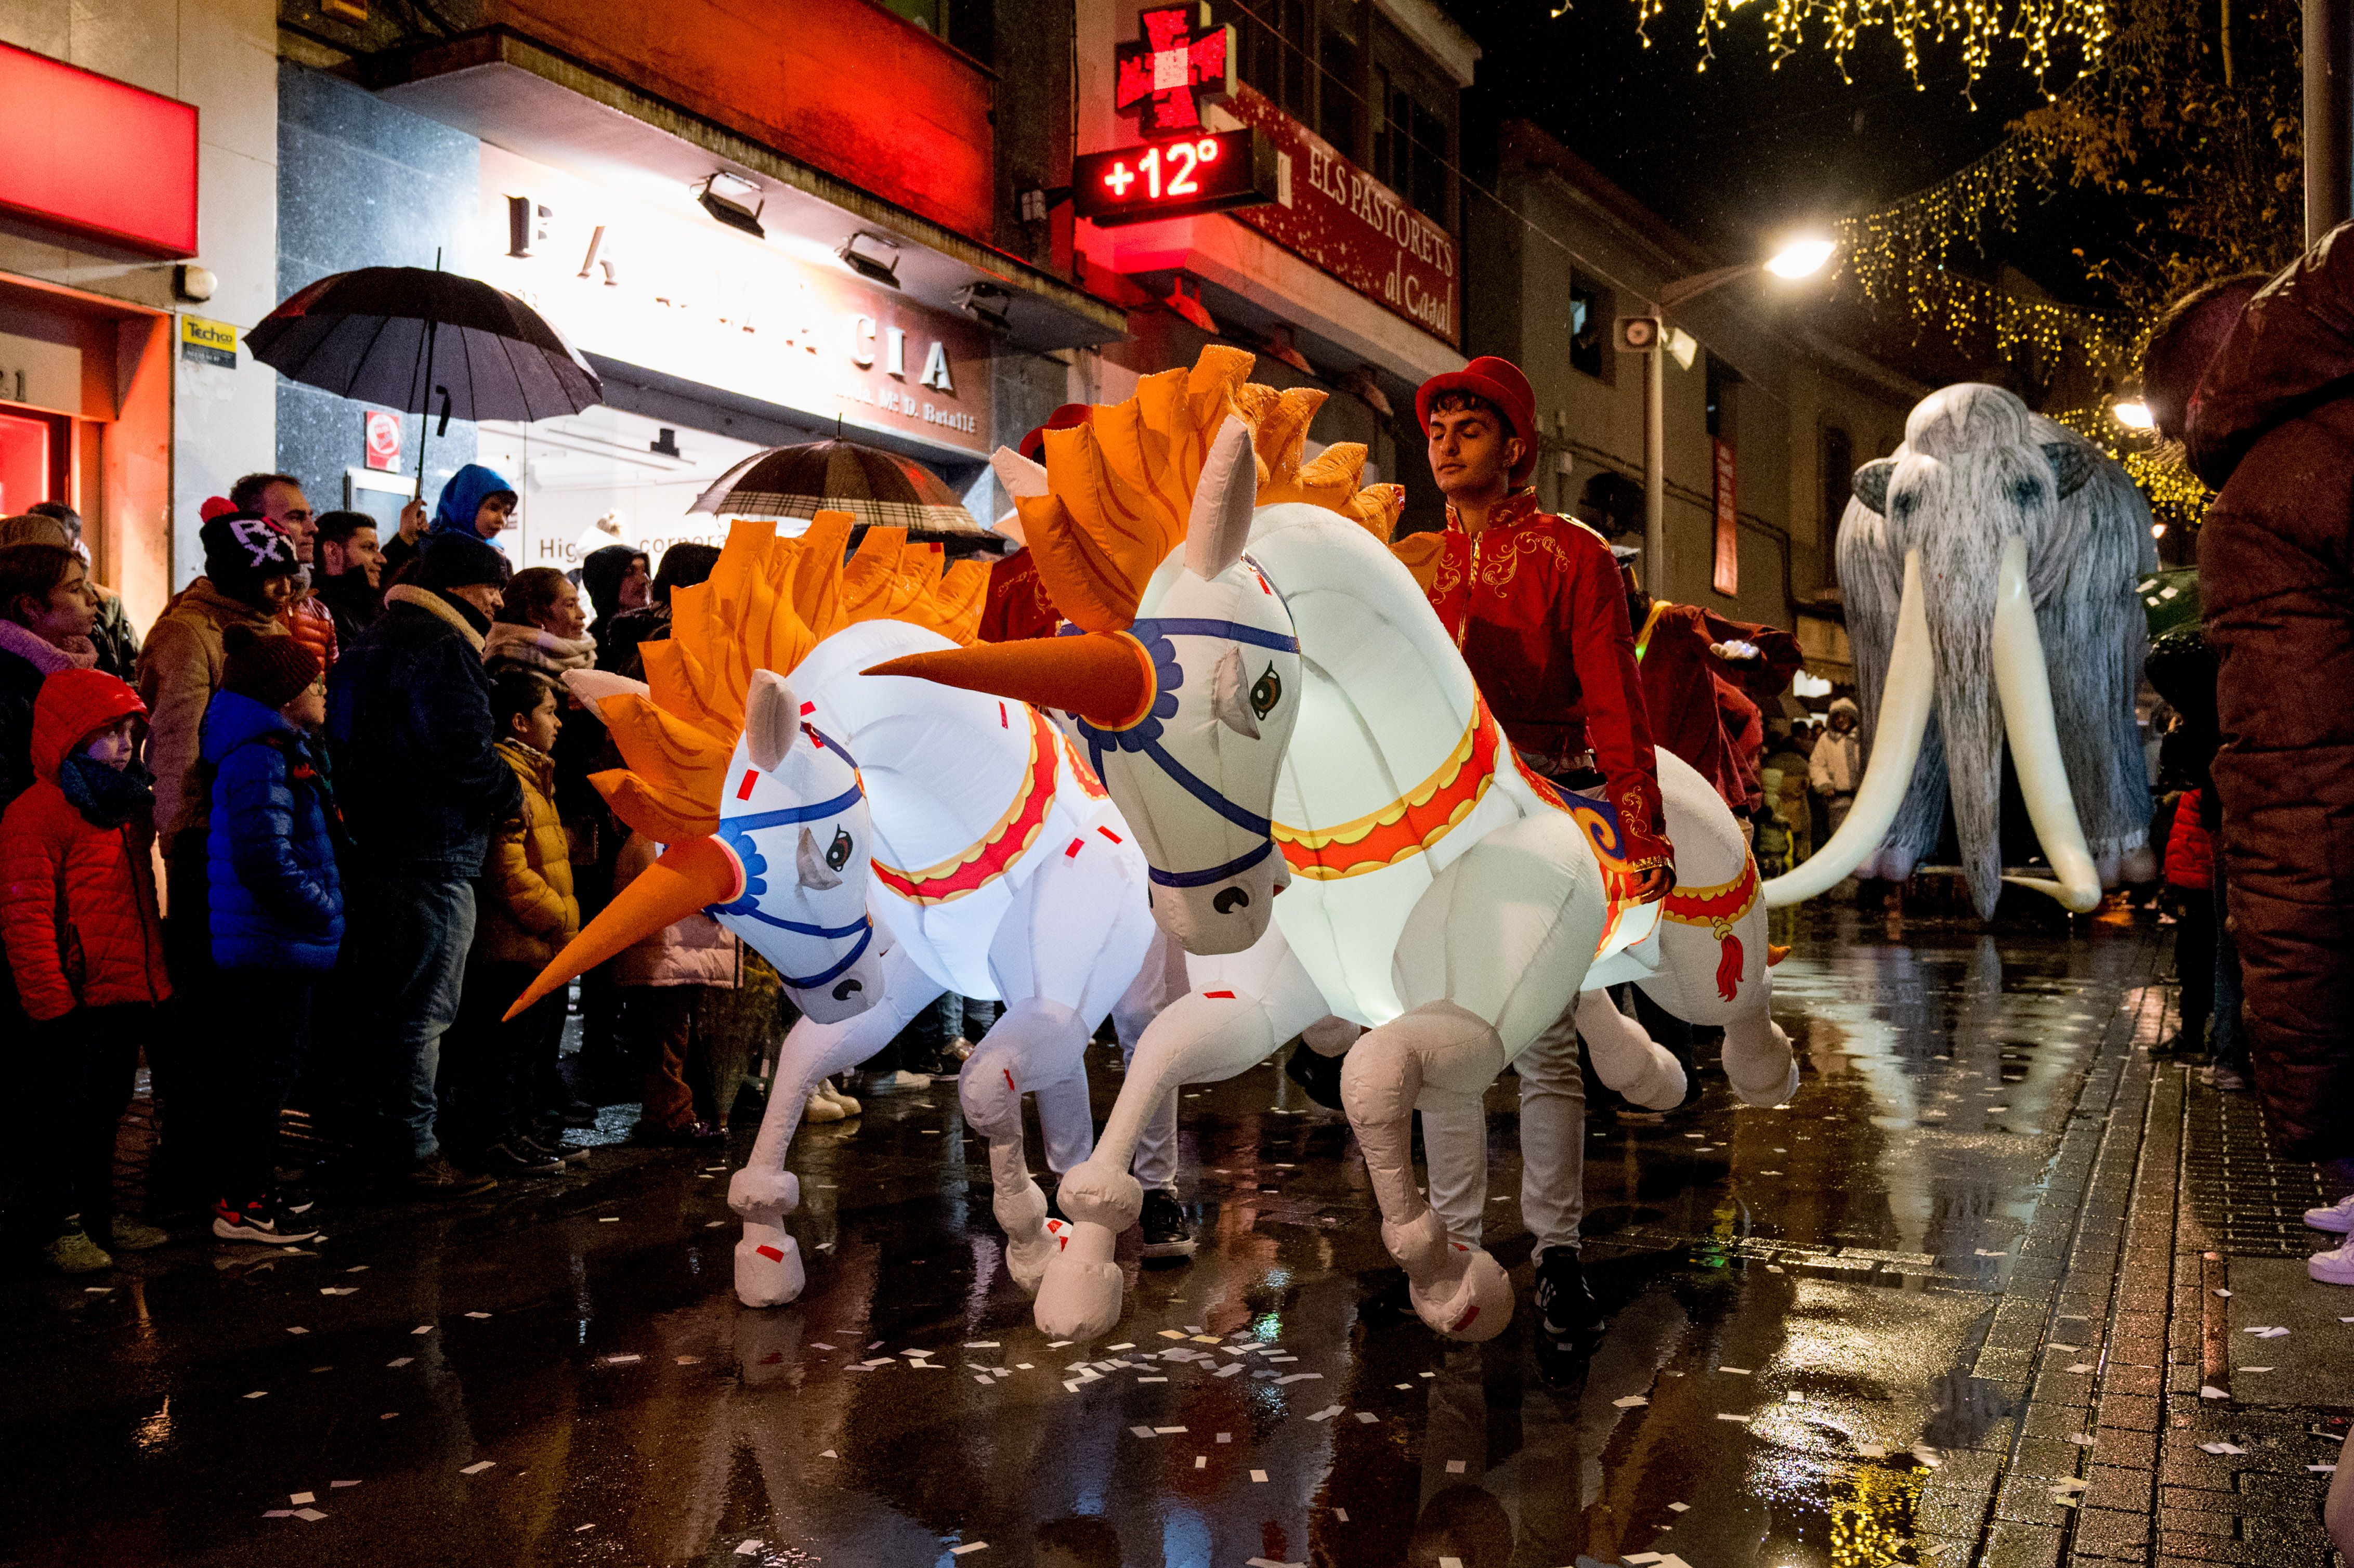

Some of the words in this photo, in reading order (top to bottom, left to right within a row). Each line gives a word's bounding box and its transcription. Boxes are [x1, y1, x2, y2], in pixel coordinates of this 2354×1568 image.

[1309, 145, 1346, 206] ELS
[1351, 175, 1453, 278] PASTORETS
[1385, 250, 1403, 306] al
[1405, 274, 1452, 335] Casal
[904, 396, 922, 417] D.
